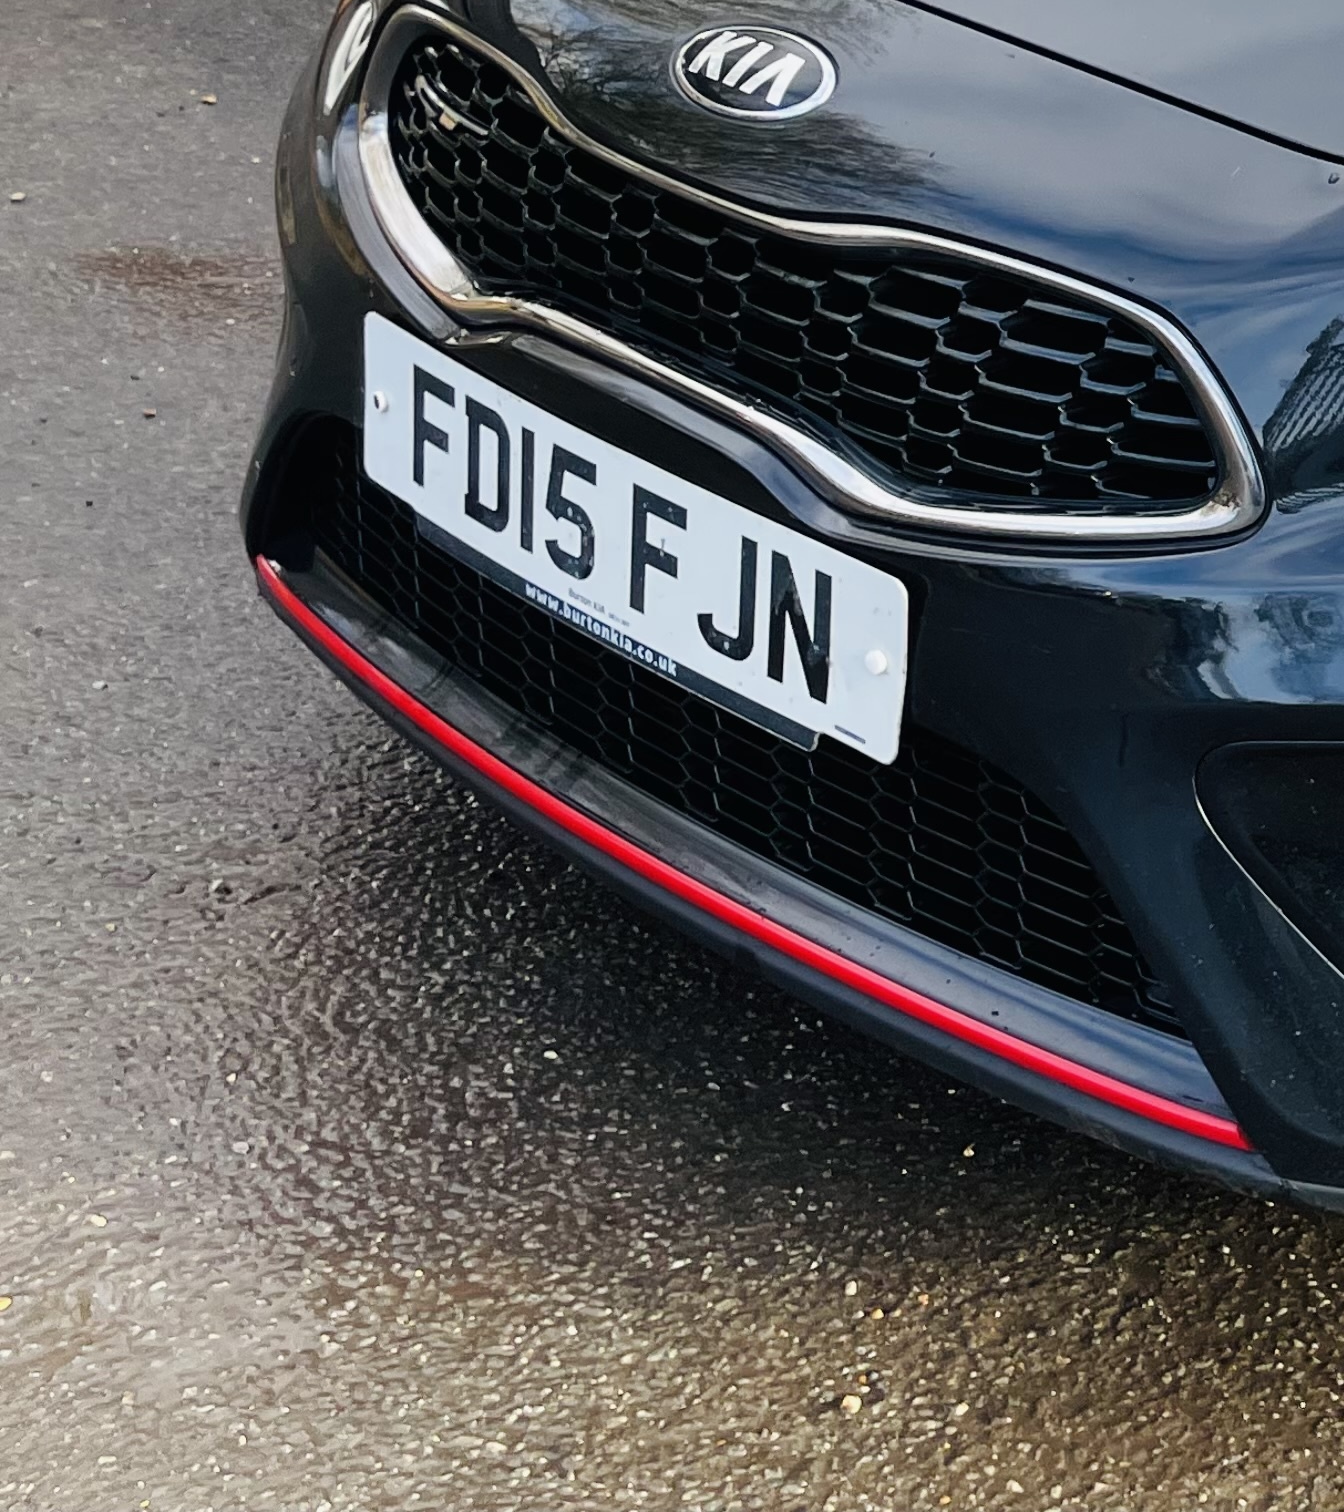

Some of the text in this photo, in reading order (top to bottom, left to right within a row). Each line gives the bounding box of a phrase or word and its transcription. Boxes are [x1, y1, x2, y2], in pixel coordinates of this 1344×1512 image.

[688, 30, 807, 117] KIA
[412, 363, 598, 581] FD15
[524, 582, 678, 678] www.burtonkia.co.uk
